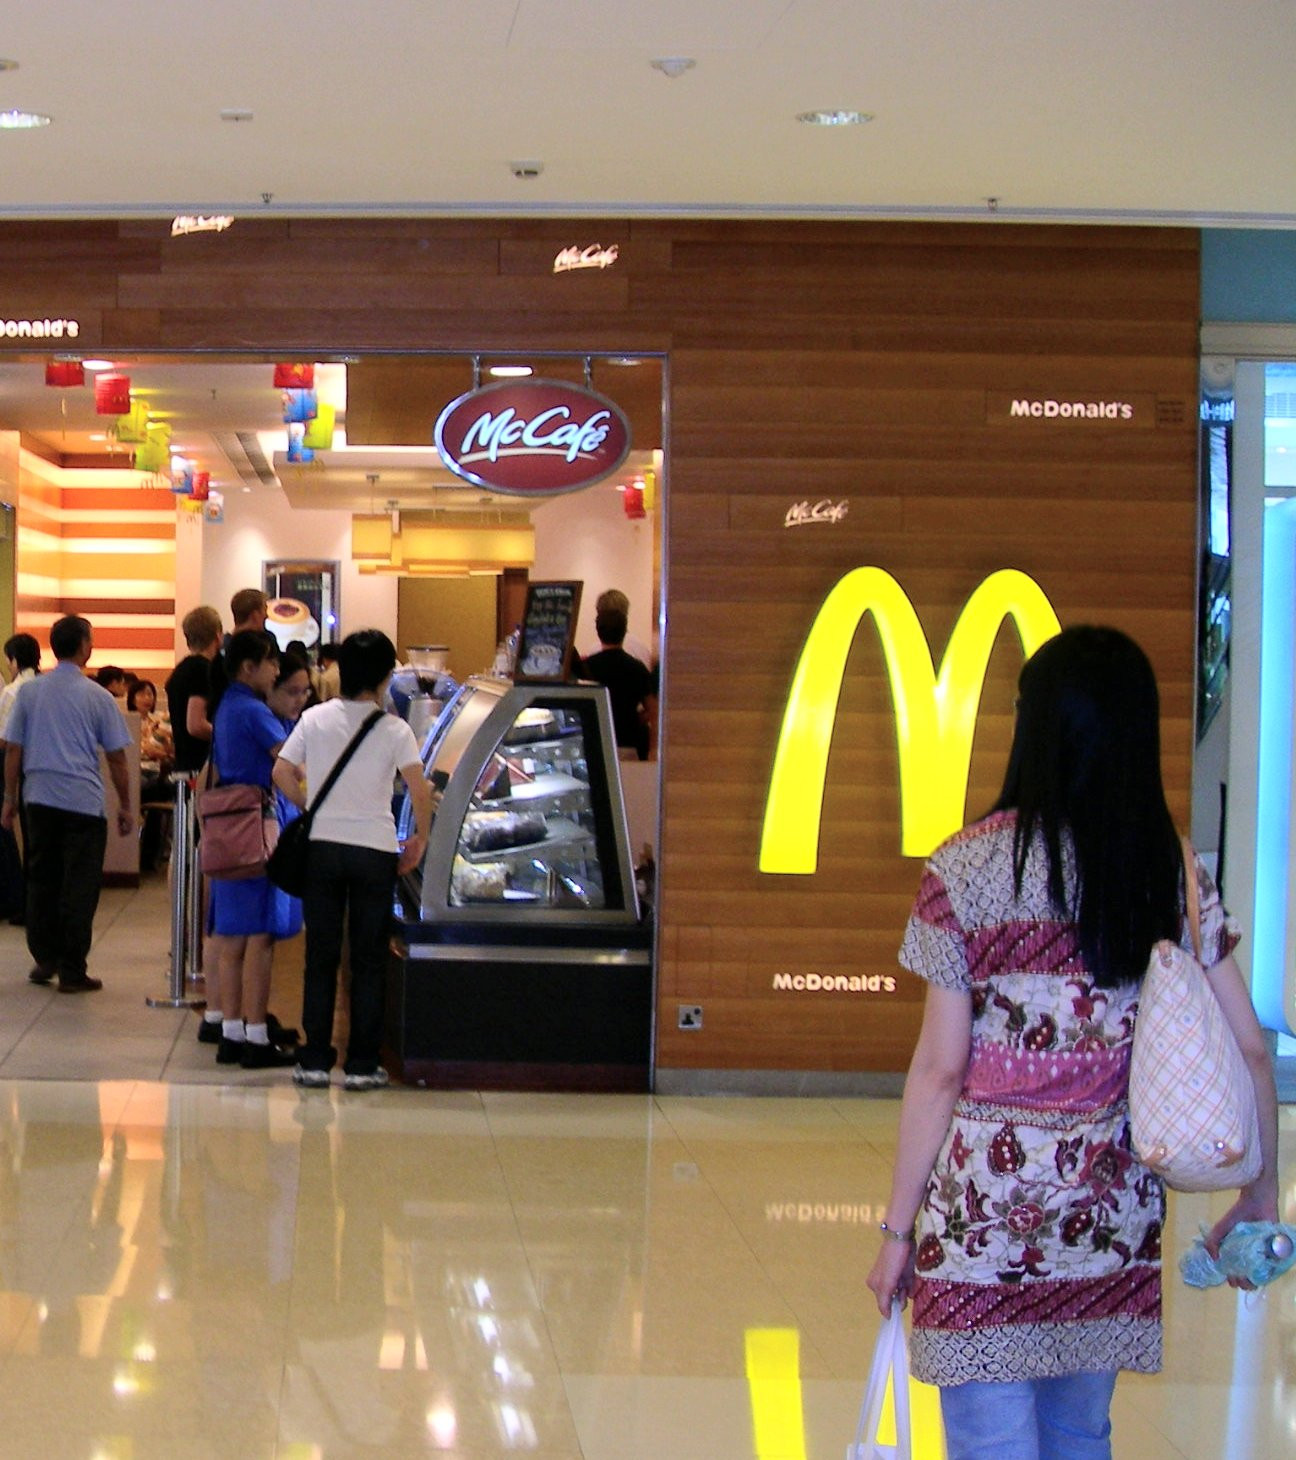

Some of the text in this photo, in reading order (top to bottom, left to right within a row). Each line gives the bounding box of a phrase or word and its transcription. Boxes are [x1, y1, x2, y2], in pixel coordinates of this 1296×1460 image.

[1010, 399, 1133, 419] McDonald's
[459, 405, 610, 463] McCafé
[772, 973, 896, 992] McDonald's
